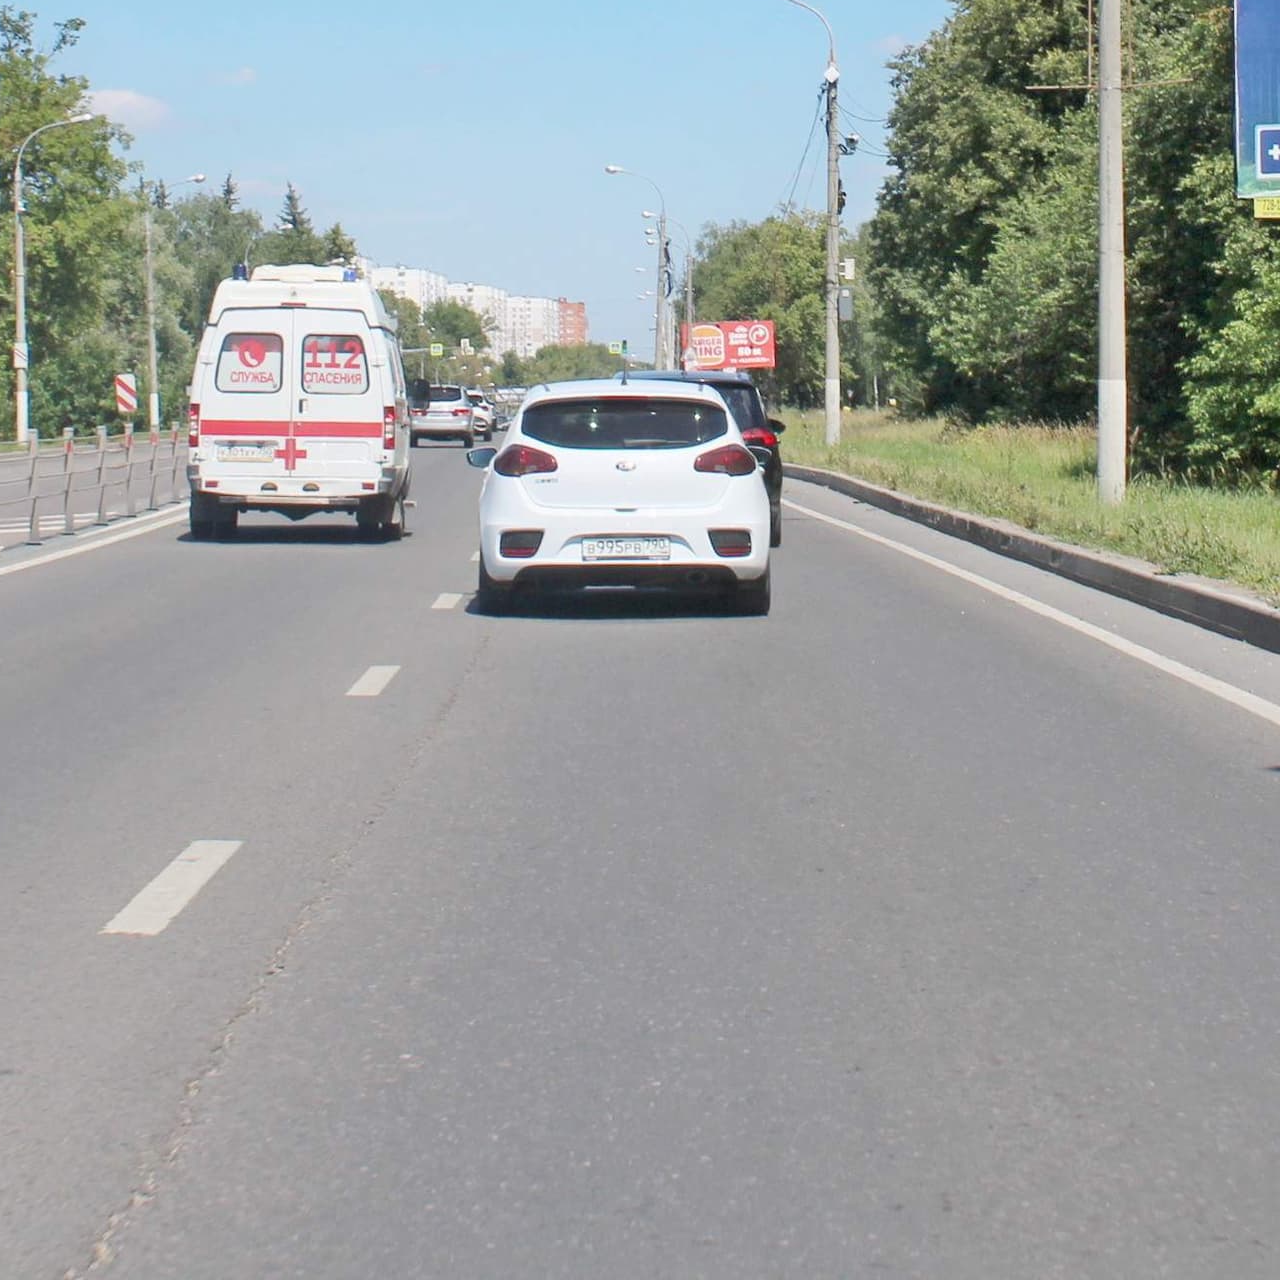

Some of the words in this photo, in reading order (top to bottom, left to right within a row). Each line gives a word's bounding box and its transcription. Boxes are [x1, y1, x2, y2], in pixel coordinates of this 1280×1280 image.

[692, 337, 722, 346] URGER
[305, 340, 362, 369] 112
[230, 371, 275, 384] СЛУЖБА
[304, 371, 362, 385] СПАСЕНИЯ
